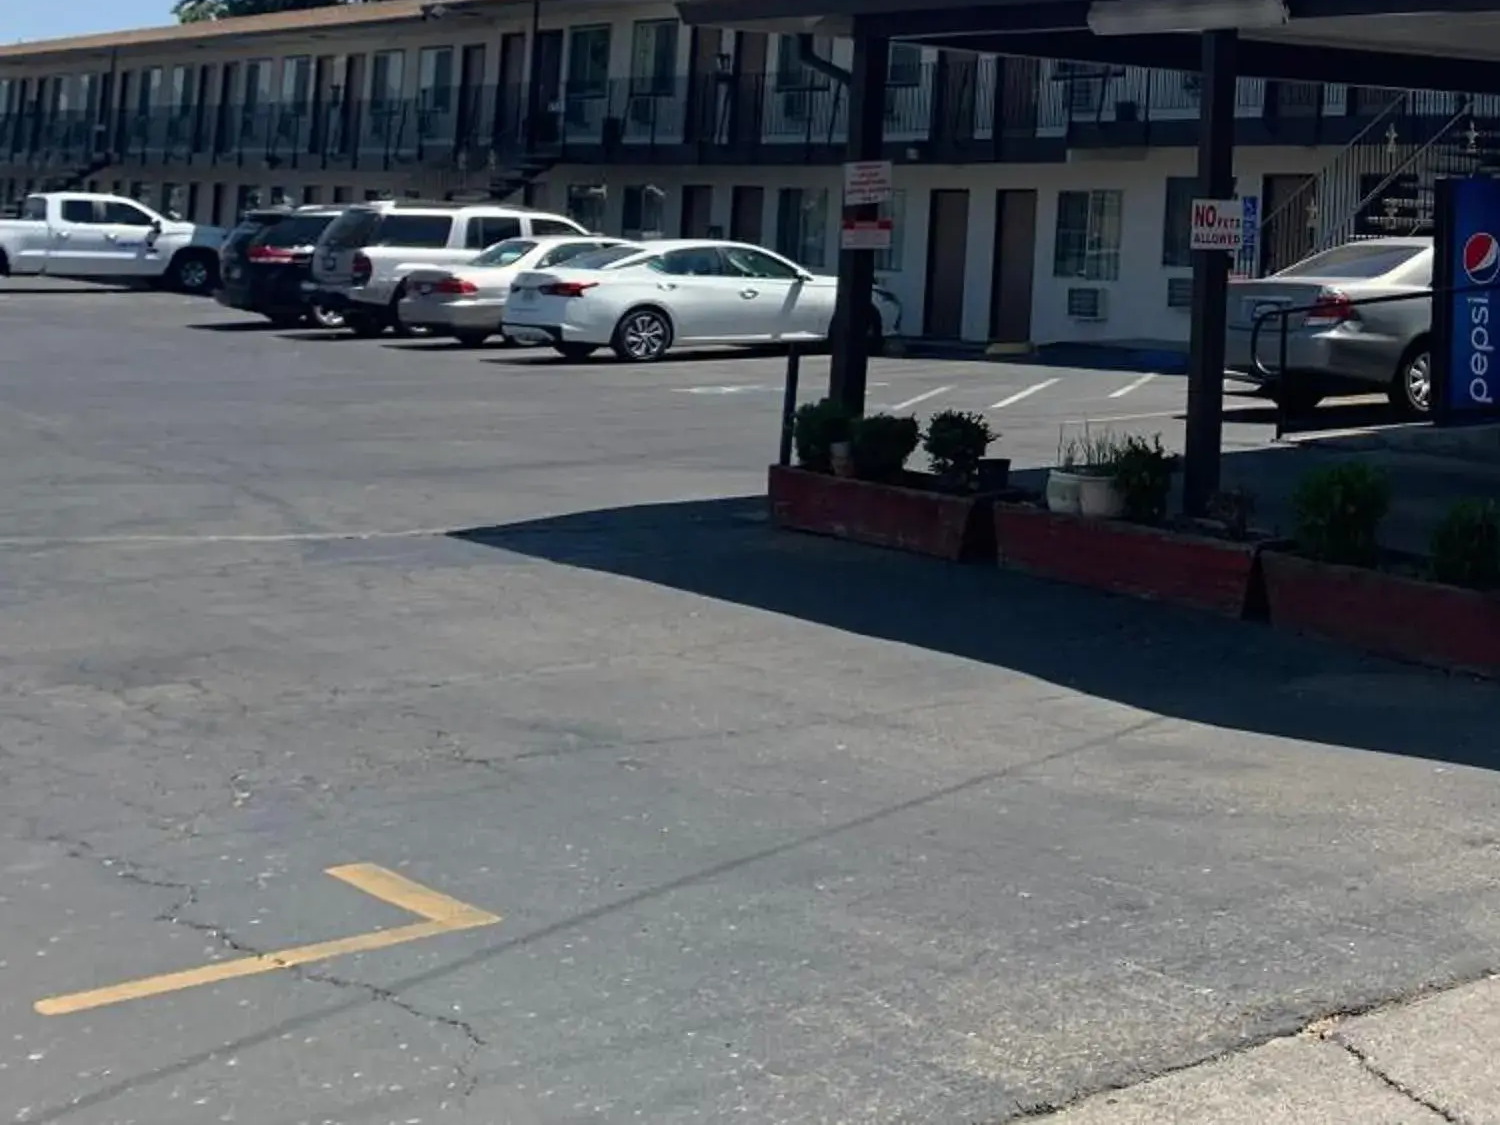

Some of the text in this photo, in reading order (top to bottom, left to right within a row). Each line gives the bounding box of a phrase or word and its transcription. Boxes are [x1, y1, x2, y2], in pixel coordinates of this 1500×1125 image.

[1194, 204, 1217, 227] NO
[1218, 217, 1240, 229] PETS
[1193, 233, 1241, 245] ALLOWED
[1467, 296, 1495, 403] pepsi
